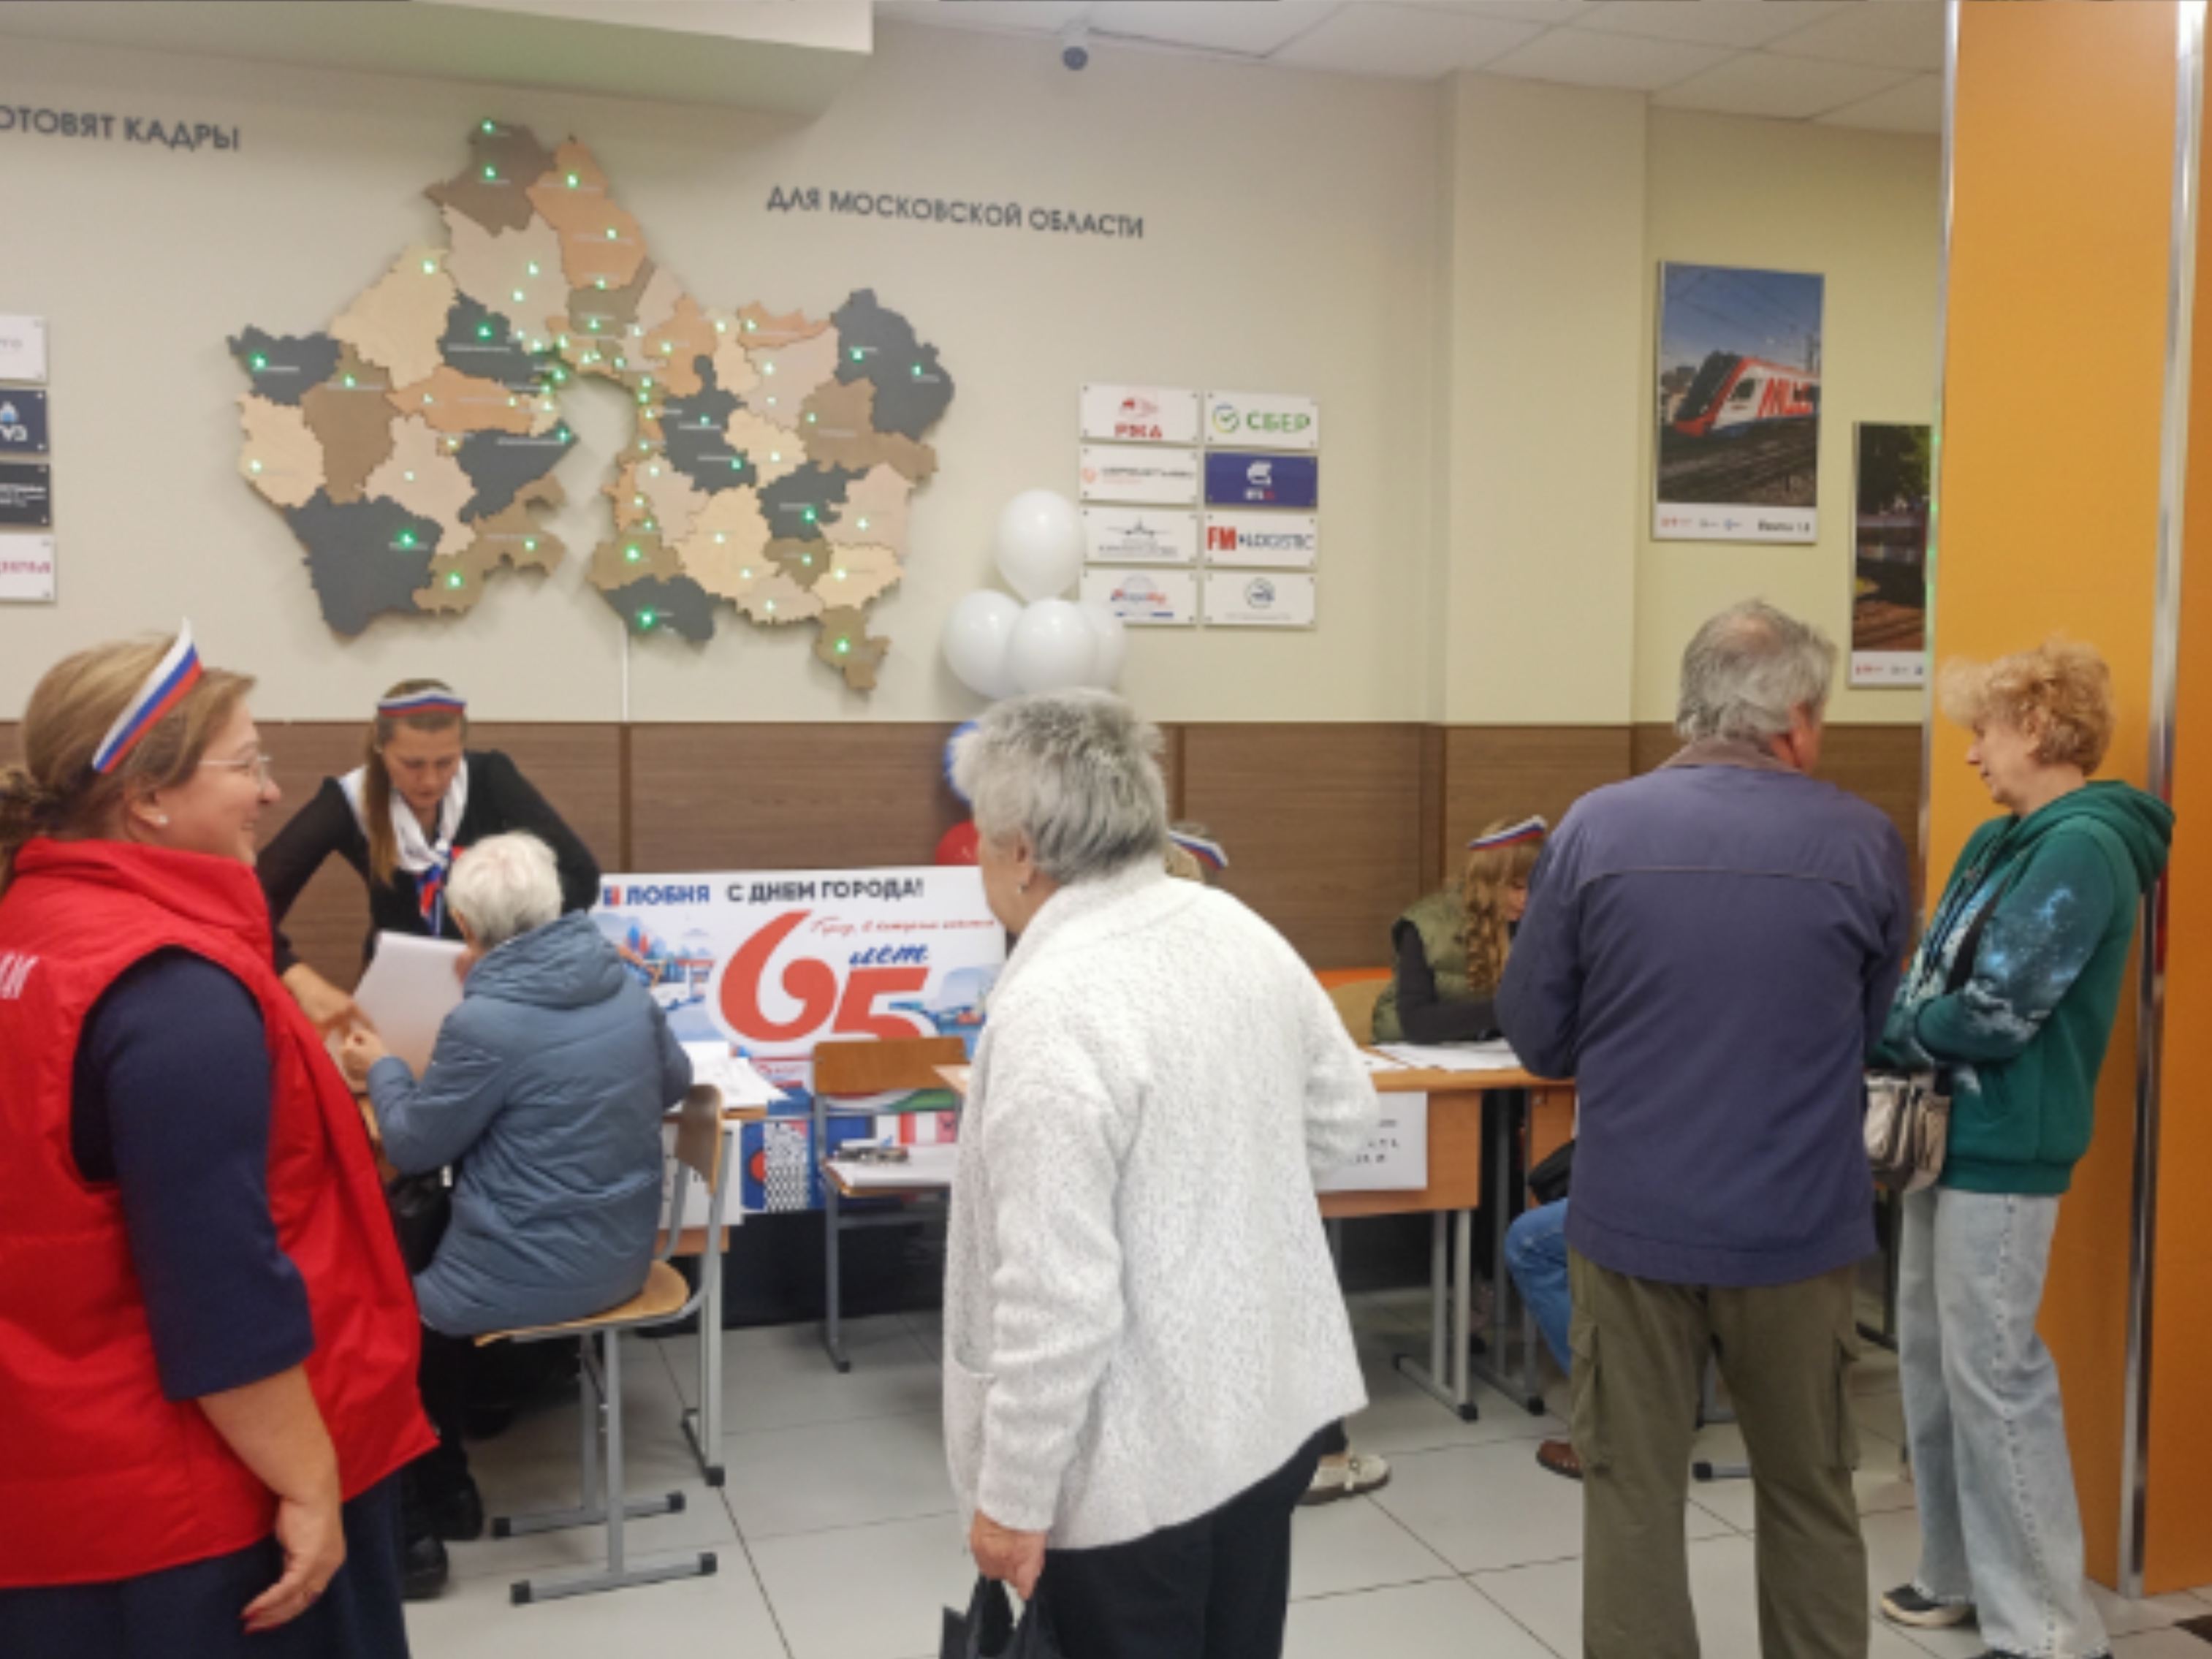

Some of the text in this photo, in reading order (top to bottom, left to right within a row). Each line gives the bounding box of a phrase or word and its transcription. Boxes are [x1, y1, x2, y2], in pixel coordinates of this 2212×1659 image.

[123, 117, 239, 151] КАДРЫ
[767, 185, 1143, 239] ДЛЯ МОСКОВСКОЙ ОБЛАСТИ
[1247, 412, 1311, 433] СБЕР
[1208, 526, 1236, 551] FM
[626, 885, 710, 906] ЛОБНЯ
[728, 884, 744, 902] С
[821, 878, 925, 901] ГОРОДА!
[720, 910, 931, 1043] 65
